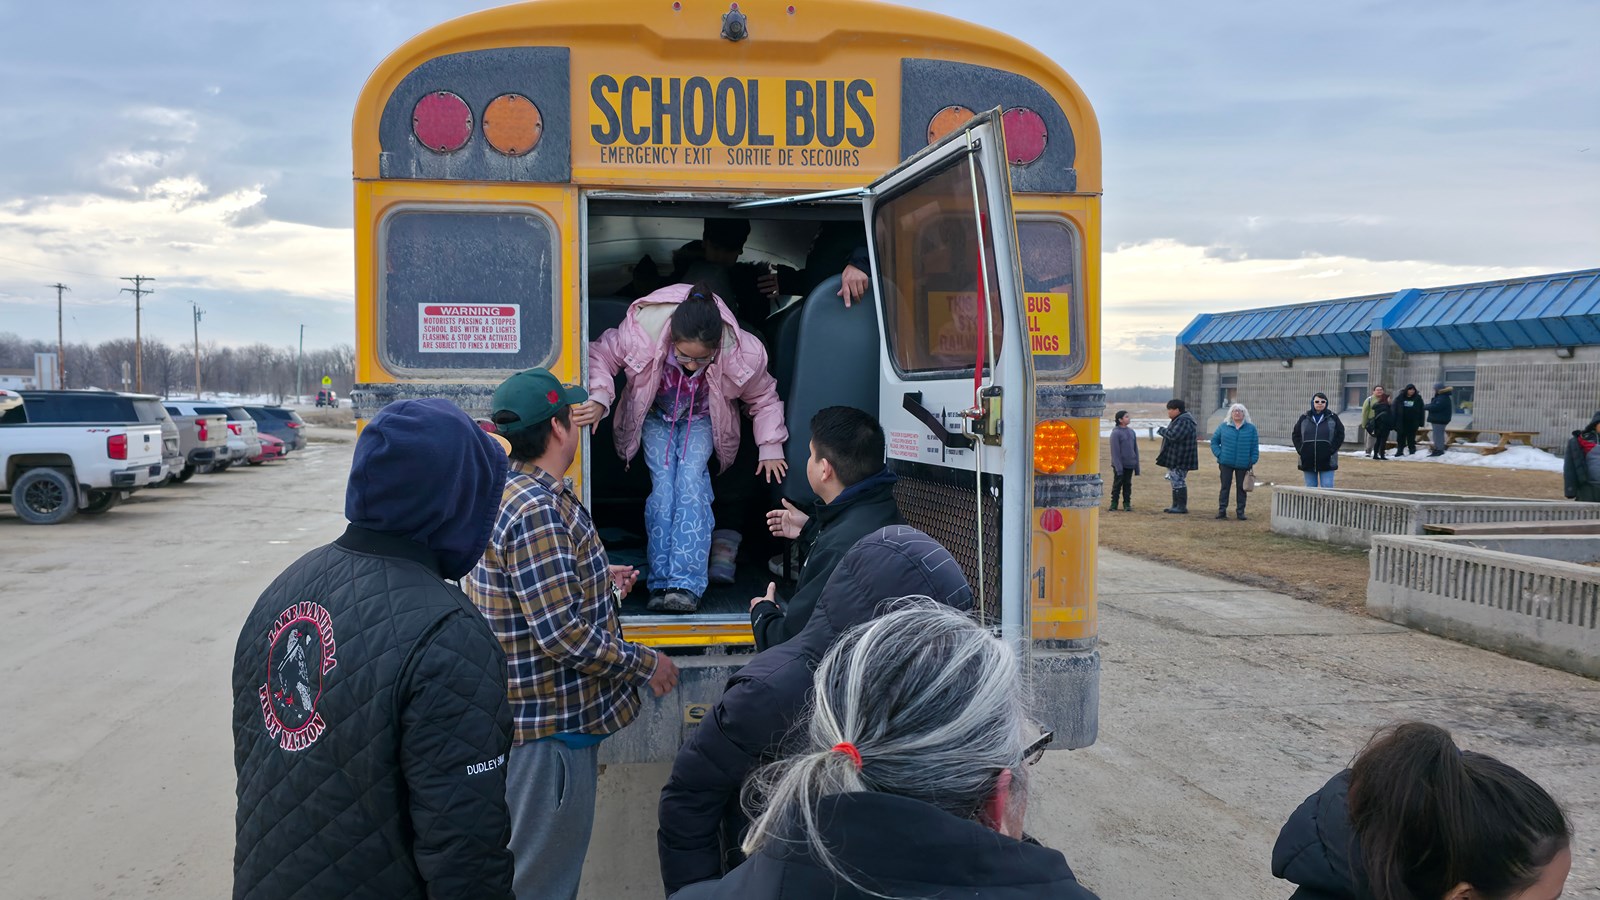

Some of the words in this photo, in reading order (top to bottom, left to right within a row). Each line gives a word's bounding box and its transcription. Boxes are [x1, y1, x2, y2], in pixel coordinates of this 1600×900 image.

[590, 74, 775, 147] SCHOOL
[785, 78, 875, 148] BUS
[600, 146, 678, 164] EMERGENCY
[685, 147, 712, 165] EXIT
[727, 148, 771, 166] SORTIE
[778, 148, 794, 166] DE
[801, 149, 860, 167] SECOURS
[440, 307, 500, 316] WARNING
[1027, 296, 1051, 313] BUS
[423, 317, 456, 325] MOTORISTS
[458, 317, 483, 326] PASSING
[485, 318, 489, 326] A
[491, 318, 517, 326] STOPPED
[424, 325, 448, 333] SCHOOL
[450, 325, 462, 333] BUS
[496, 326, 517, 334] LIGHTS
[1027, 315, 1041, 332] LL
[422, 333, 450, 341] FLASHING
[489, 334, 518, 342] ACTIVATED
[422, 341, 434, 349] ARE
[435, 341, 458, 349] SUBJECT
[459, 341, 467, 349] TO
[491, 342, 518, 350] DEMERITS
[268, 604, 299, 645] LAKE
[299, 601, 338, 675] MANITOBA
[259, 683, 282, 739] FIRST
[280, 712, 326, 751] NATION
[466, 758, 498, 776] DUDLEY
